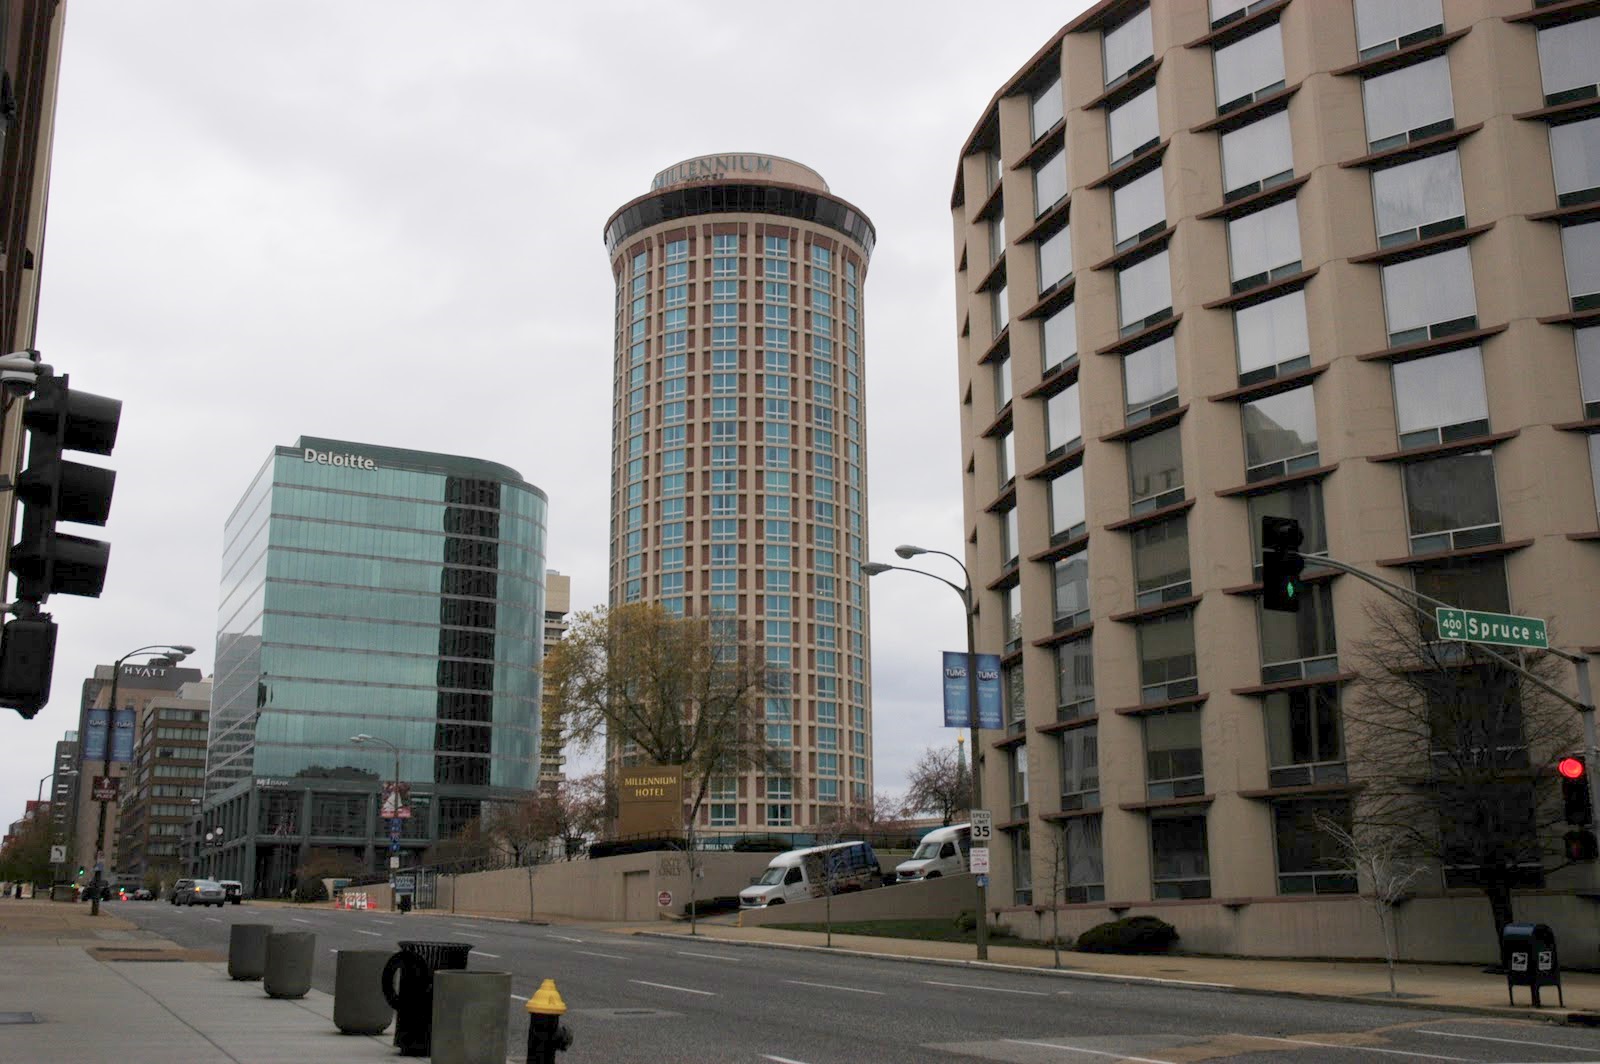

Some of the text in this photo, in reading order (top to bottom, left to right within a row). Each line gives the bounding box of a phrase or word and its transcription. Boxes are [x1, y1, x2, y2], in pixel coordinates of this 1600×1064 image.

[653, 156, 772, 188] MILLENNIUM
[1442, 619, 1462, 630] 400
[1468, 617, 1545, 640] Spruce St
[124, 667, 166, 678] HYATT
[945, 668, 967, 677] TUMS
[977, 671, 999, 679] TUMS
[624, 776, 677, 786] MILLENNIUM
[635, 788, 664, 797] HOTEL
[973, 825, 990, 837] 35
